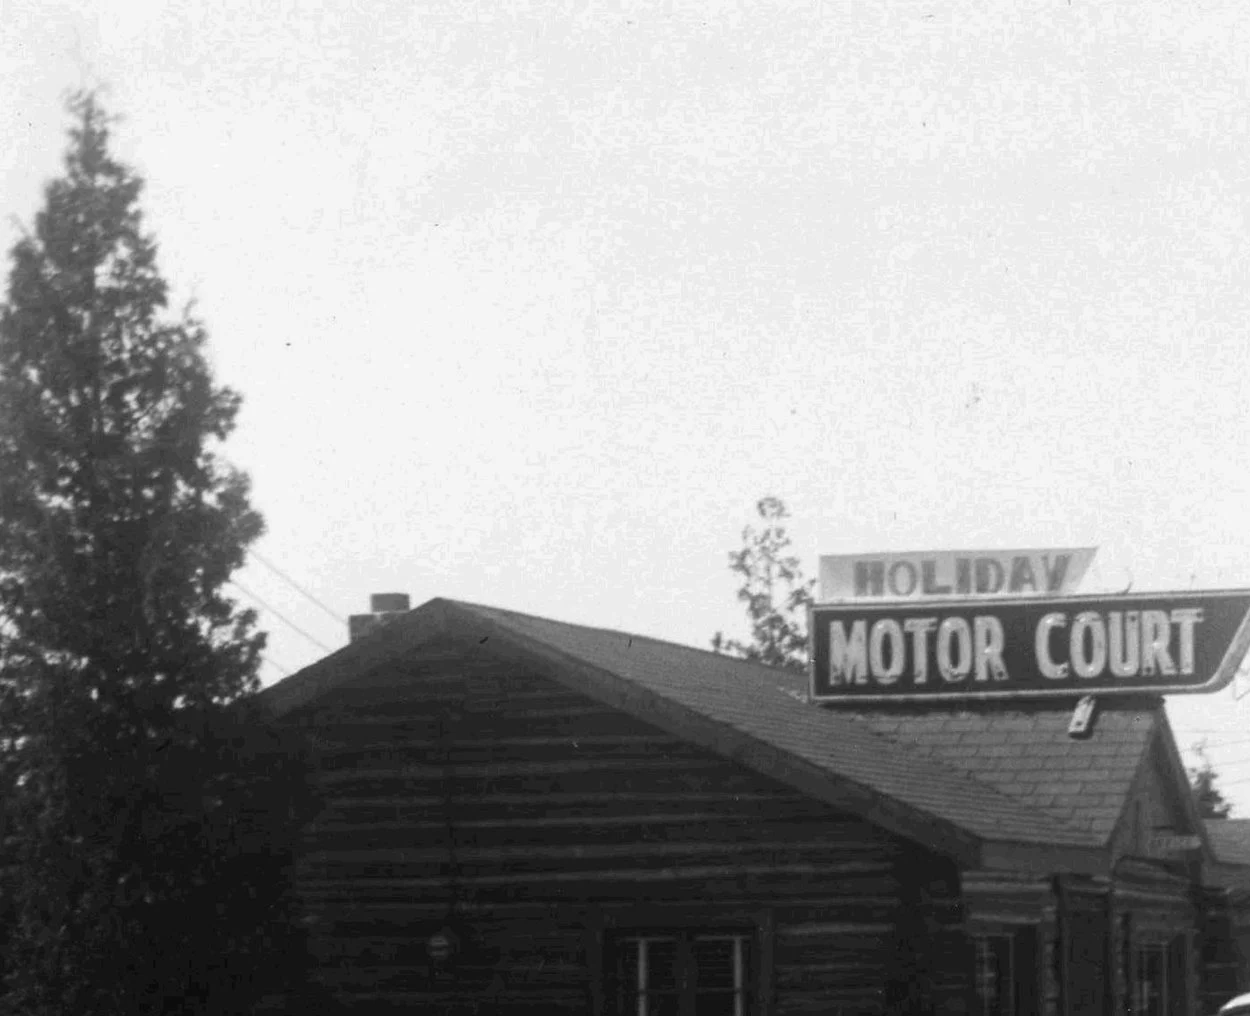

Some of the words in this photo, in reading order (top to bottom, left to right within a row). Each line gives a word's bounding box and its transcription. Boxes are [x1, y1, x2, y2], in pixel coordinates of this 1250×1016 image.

[854, 553, 1072, 597] HOLIDAY
[828, 616, 1008, 686] MOTOR
[1034, 608, 1203, 680] COURT
